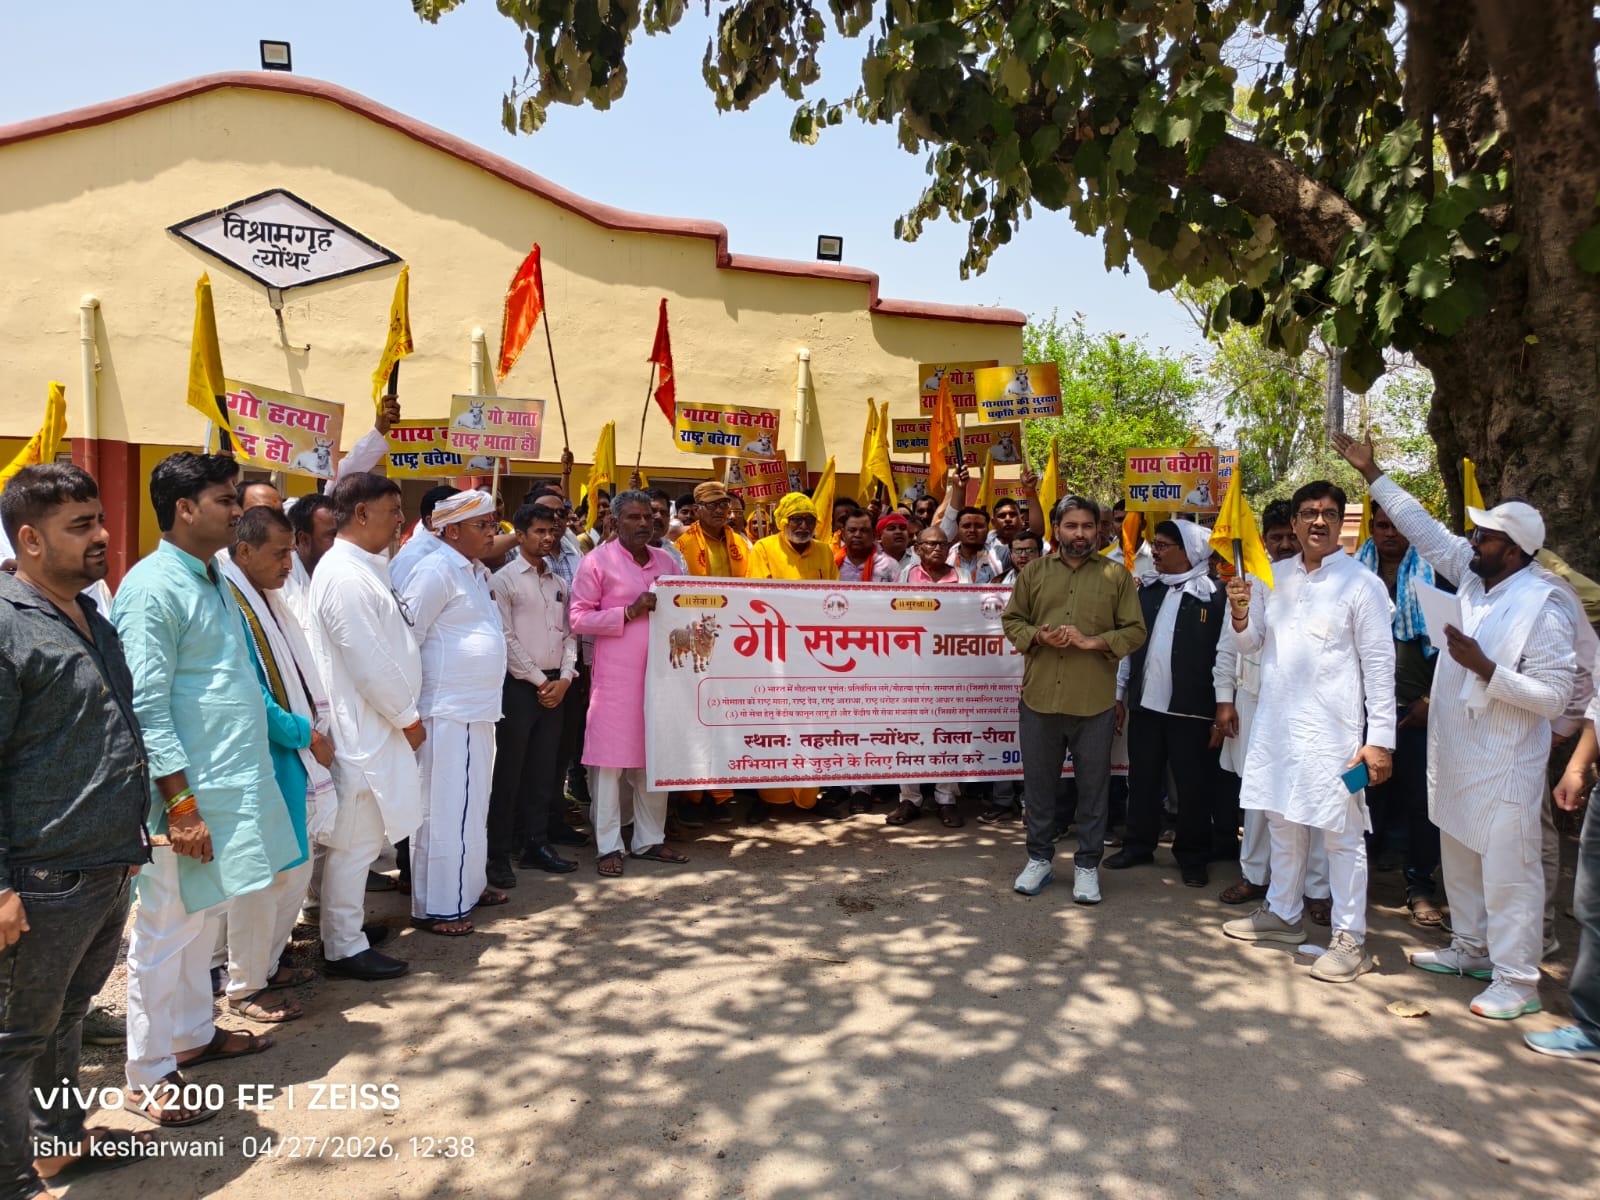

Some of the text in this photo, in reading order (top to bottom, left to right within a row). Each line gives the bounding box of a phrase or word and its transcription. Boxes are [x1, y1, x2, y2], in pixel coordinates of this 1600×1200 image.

[252, 245, 312, 272] त्योंथर
[1016, 397, 1029, 405] की
[1016, 406, 1030, 416] की
[226, 390, 331, 434] गो हत्या
[487, 406, 538, 427] गो माता
[682, 408, 778, 430] गाय बचेगी
[390, 427, 435, 442] गाय
[680, 430, 742, 446] राष्ट्र बचेगा
[896, 423, 916, 433] गाय
[264, 434, 294, 464] हो
[451, 432, 480, 452] राष्ट्र
[484, 434, 518, 452] माता
[520, 432, 536, 452] हो
[390, 448, 462, 469] राष्ट्र बचेगा
[743, 461, 784, 477] गो माता
[1129, 452, 1214, 474] गाय बचेगी
[746, 483, 772, 498] माता
[774, 480, 788, 495] हो
[1129, 480, 1182, 502] राष्ट्र बचेगा
[796, 626, 928, 672] सम्मान
[728, 755, 788, 770] अभियान
[792, 754, 806, 769] से
[809, 752, 846, 773] जुड़ने
[848, 754, 862, 768] के
[864, 752, 894, 770] लिए
[896, 751, 926, 767] मिस
[928, 751, 959, 766] कॉल
